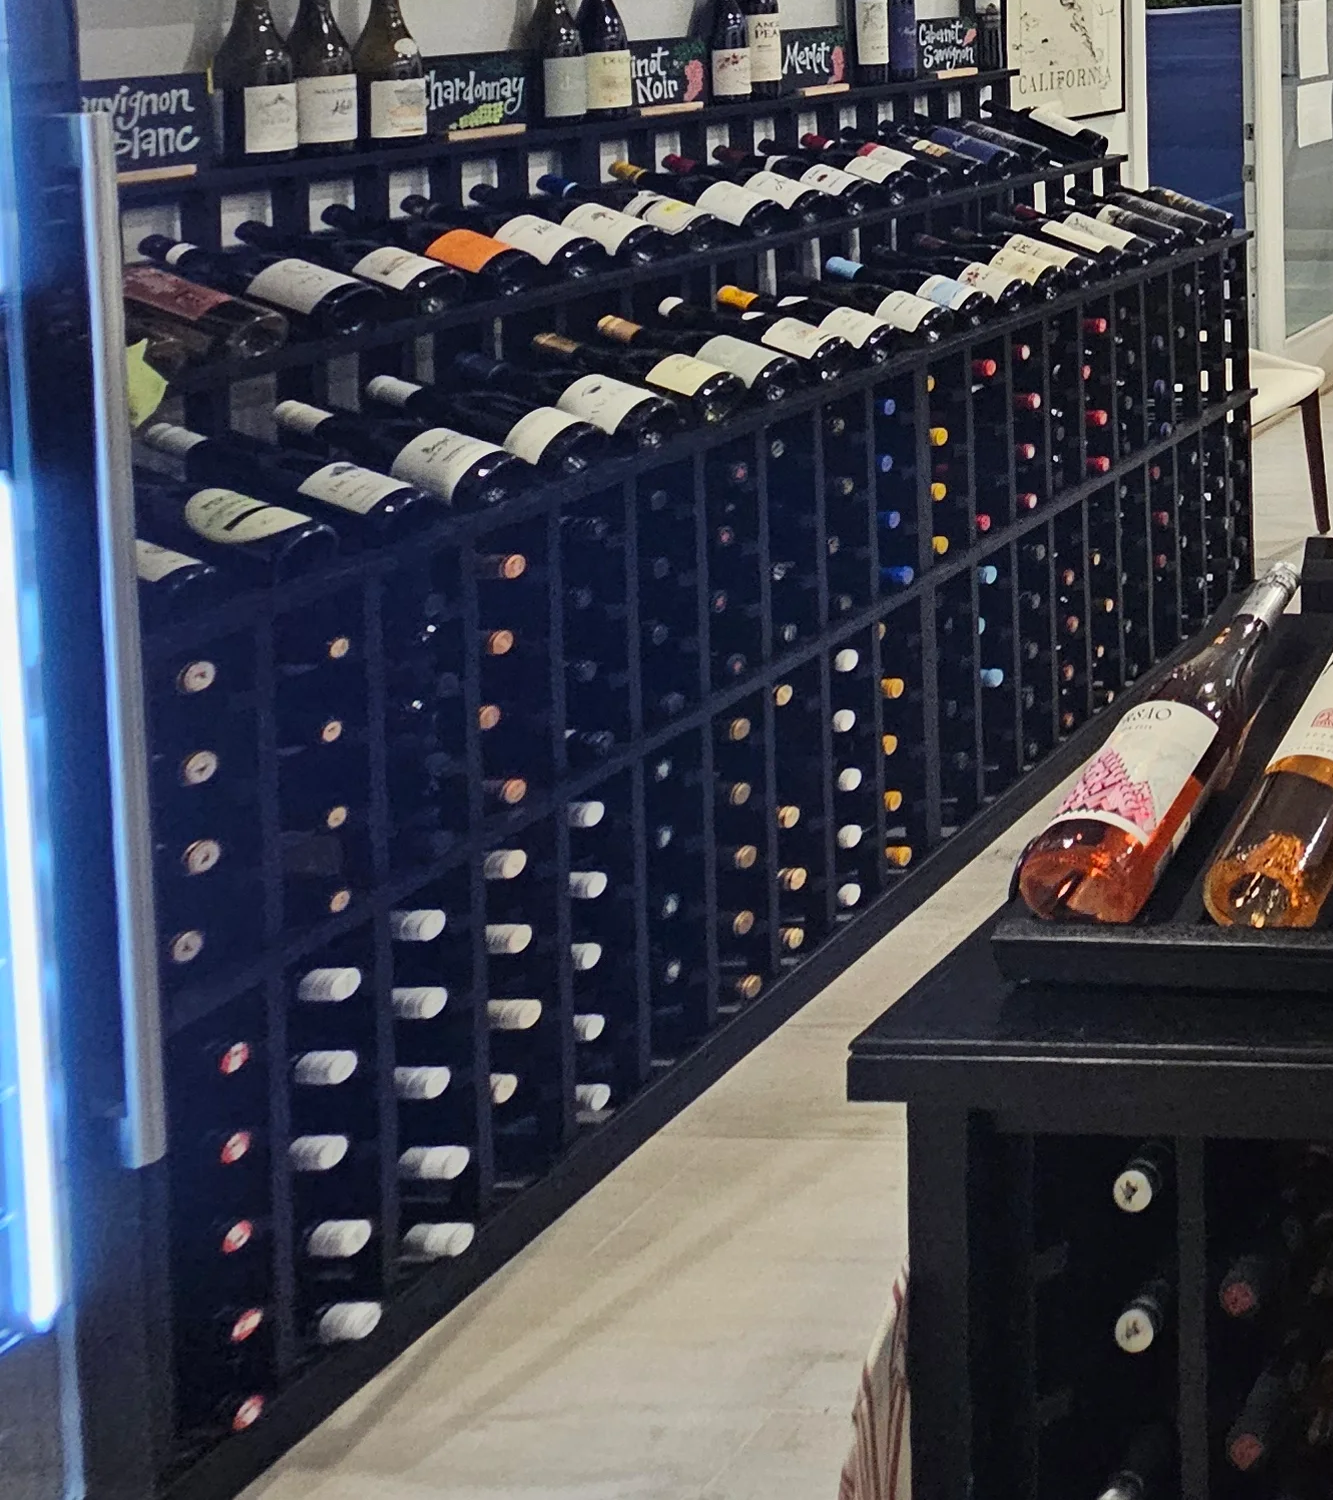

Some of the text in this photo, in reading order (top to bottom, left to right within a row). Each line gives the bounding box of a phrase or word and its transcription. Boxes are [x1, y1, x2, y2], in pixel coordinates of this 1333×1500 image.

[918, 20, 963, 47] Cabernet
[631, 46, 670, 78] inot
[781, 41, 831, 75] Merlot
[923, 45, 975, 71] Sauvignon
[635, 76, 679, 104] Noir
[1018, 64, 1113, 96] CALIFORNIA
